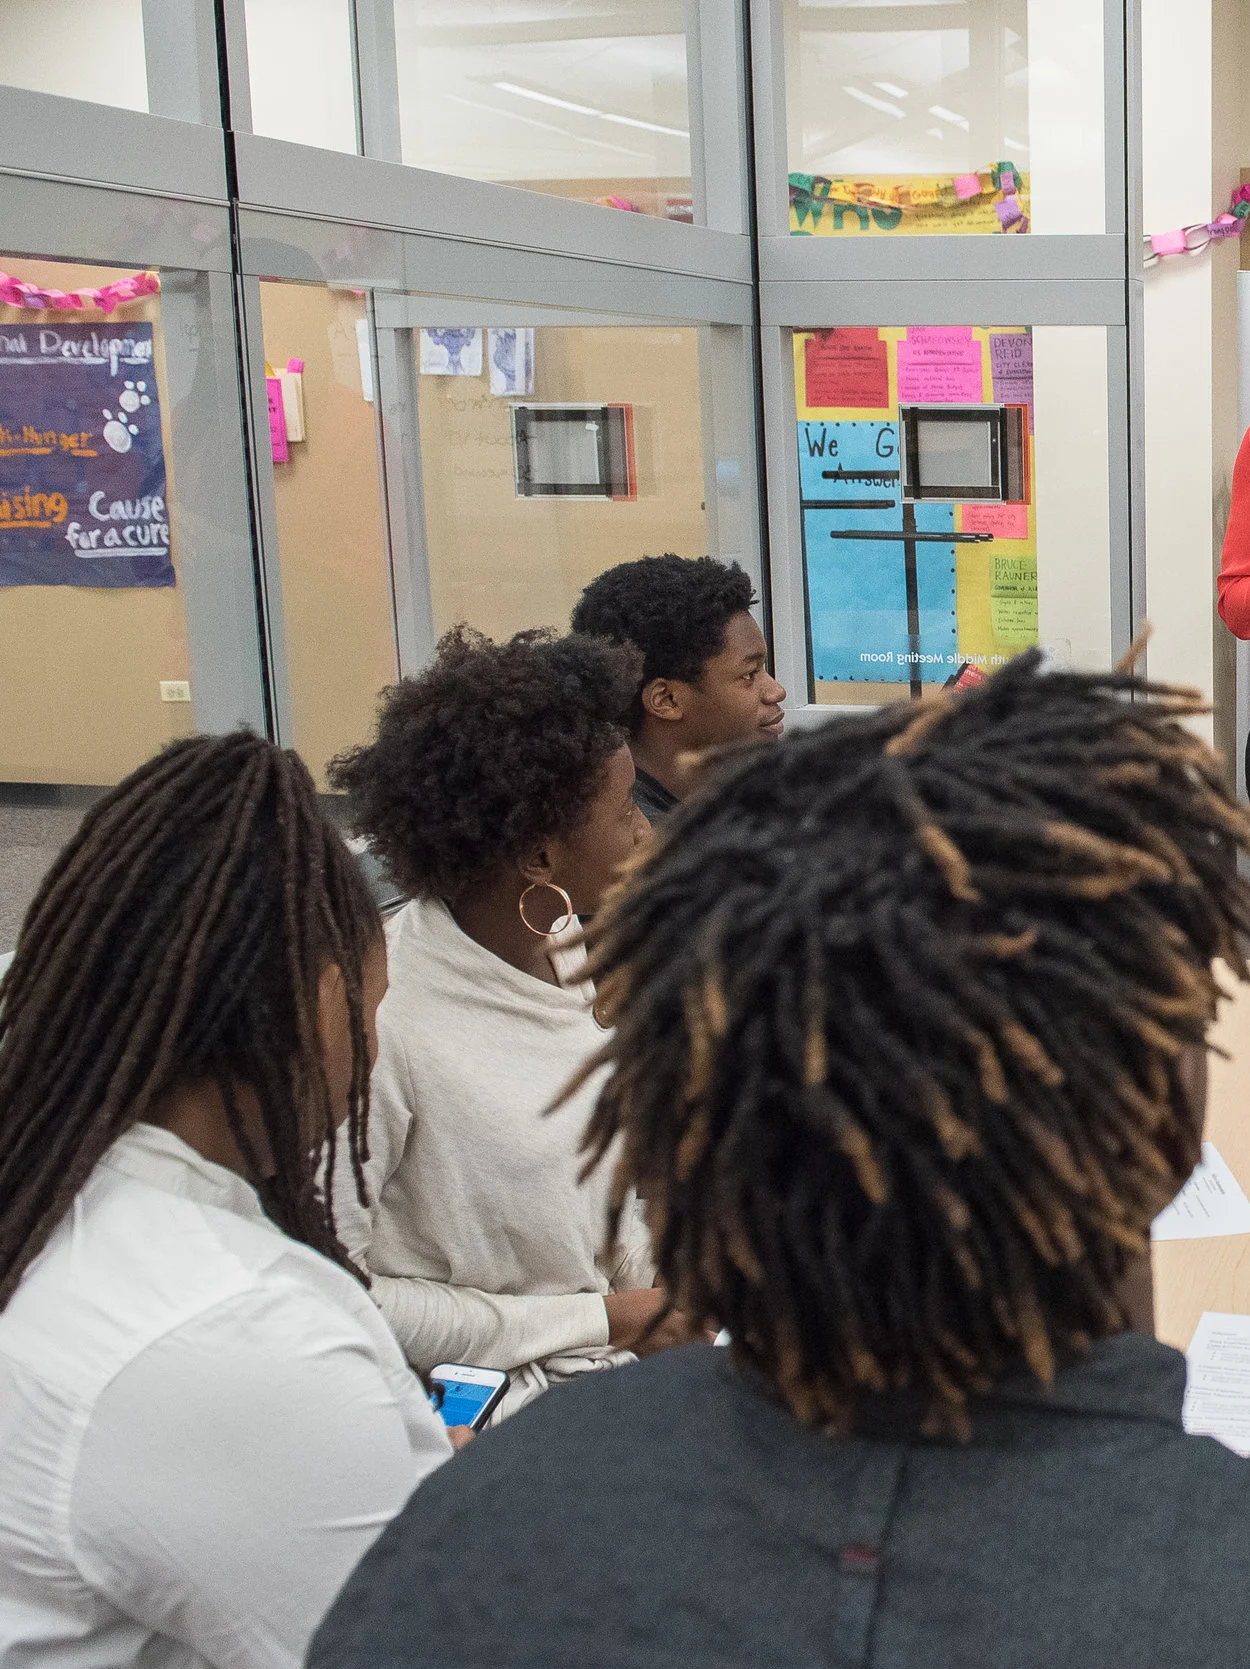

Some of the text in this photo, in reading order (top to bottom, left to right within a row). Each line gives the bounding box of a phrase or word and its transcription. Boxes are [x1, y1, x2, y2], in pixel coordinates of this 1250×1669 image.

[805, 427, 899, 458] We G
[89, 490, 165, 522] Cause
[65, 522, 101, 549] for
[994, 557, 1027, 571] BRUCE
[995, 571, 1038, 581] RAUNER
